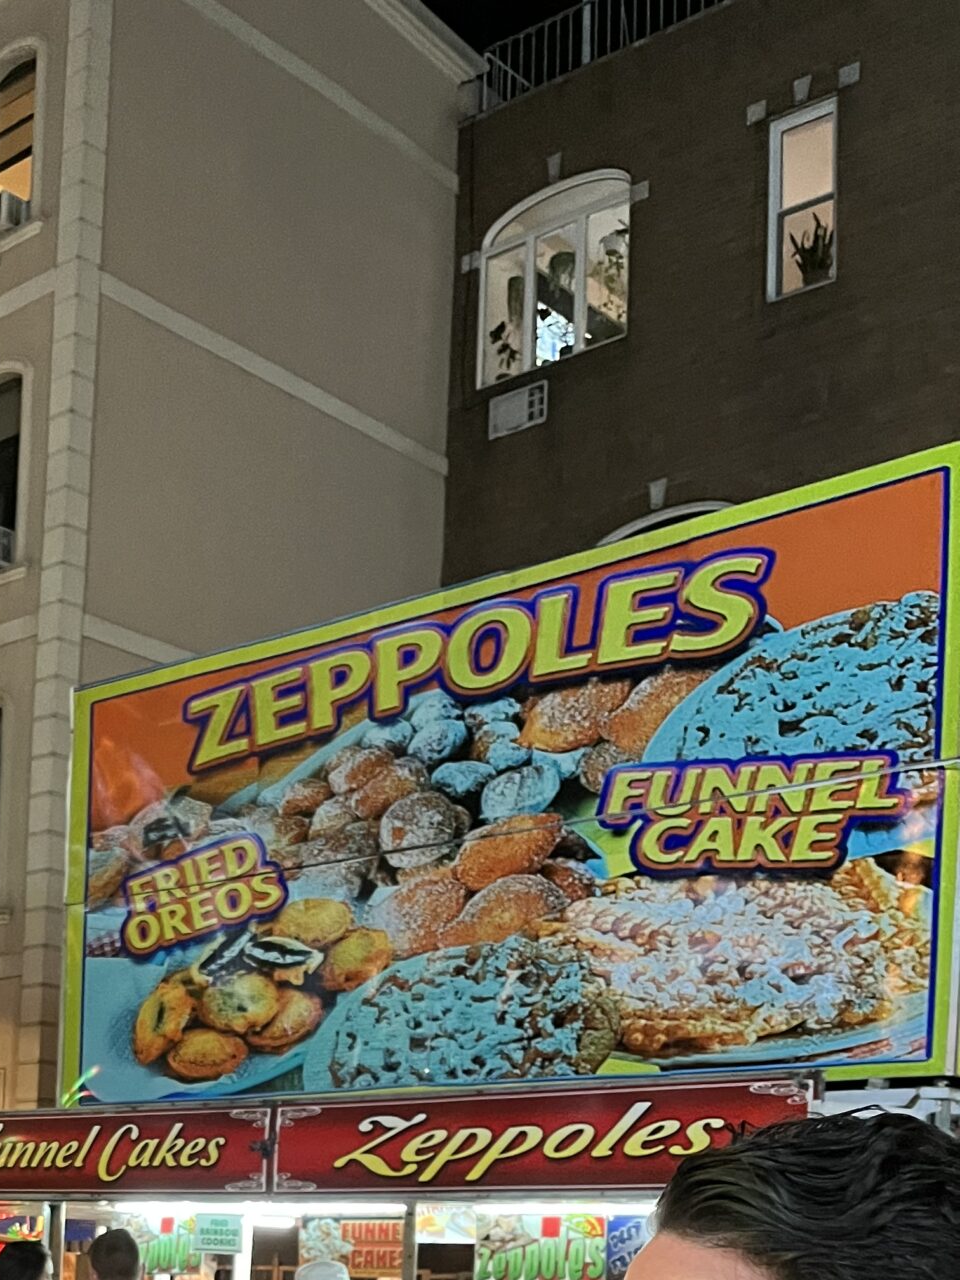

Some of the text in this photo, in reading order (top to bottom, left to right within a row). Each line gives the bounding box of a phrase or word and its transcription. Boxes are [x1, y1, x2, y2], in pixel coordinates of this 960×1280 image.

[189, 552, 771, 769] ZEPPOLES
[607, 759, 899, 816] FUNNEL
[641, 813, 843, 863] CAKE
[128, 839, 259, 912] FRIED
[126, 872, 282, 949] OREOS
[97, 1122, 226, 1182] Cakes
[333, 1100, 725, 1183] Zeppoles
[341, 1222, 402, 1242] FUNNE
